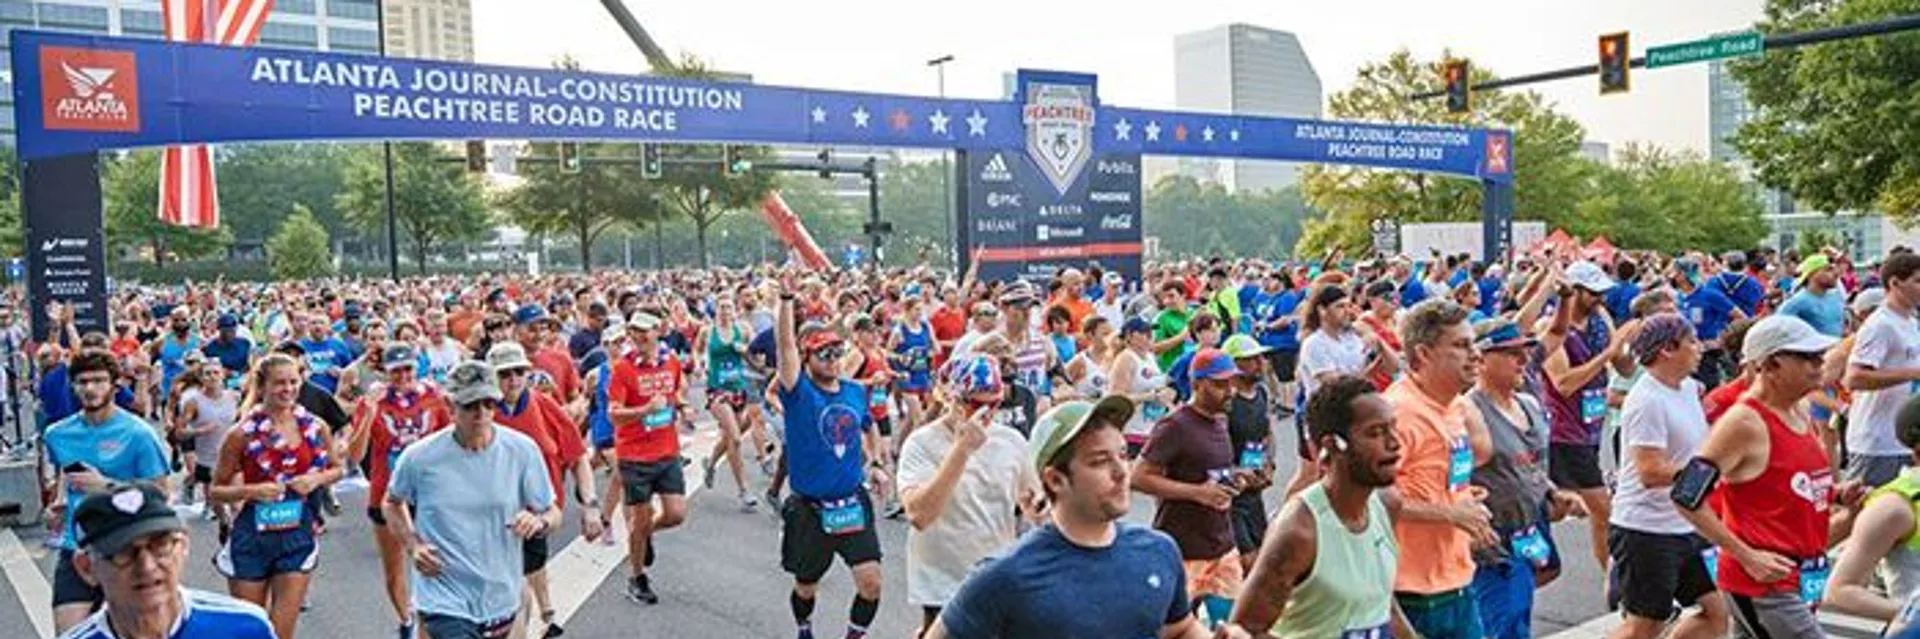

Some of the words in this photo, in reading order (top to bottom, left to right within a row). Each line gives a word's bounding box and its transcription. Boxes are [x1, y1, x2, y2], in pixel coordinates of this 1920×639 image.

[1650, 45, 1715, 63] Peachtree
[1721, 38, 1757, 54] Road
[251, 57, 400, 89] ATLANTA
[410, 67, 743, 110] JOURNAL-CONSTITUTION
[57, 98, 127, 115] ATLANTA
[354, 92, 519, 124] PEACHTREE
[529, 101, 605, 127] ROAD
[614, 107, 677, 131] RACE
[1294, 124, 1344, 140] ATLANTA
[1349, 126, 1469, 146] JOURNAL-CONSTITUTION
[1327, 142, 1386, 158] PEACHTREE
[1387, 144, 1416, 159] ROAD
[1418, 146, 1444, 160] RACE
